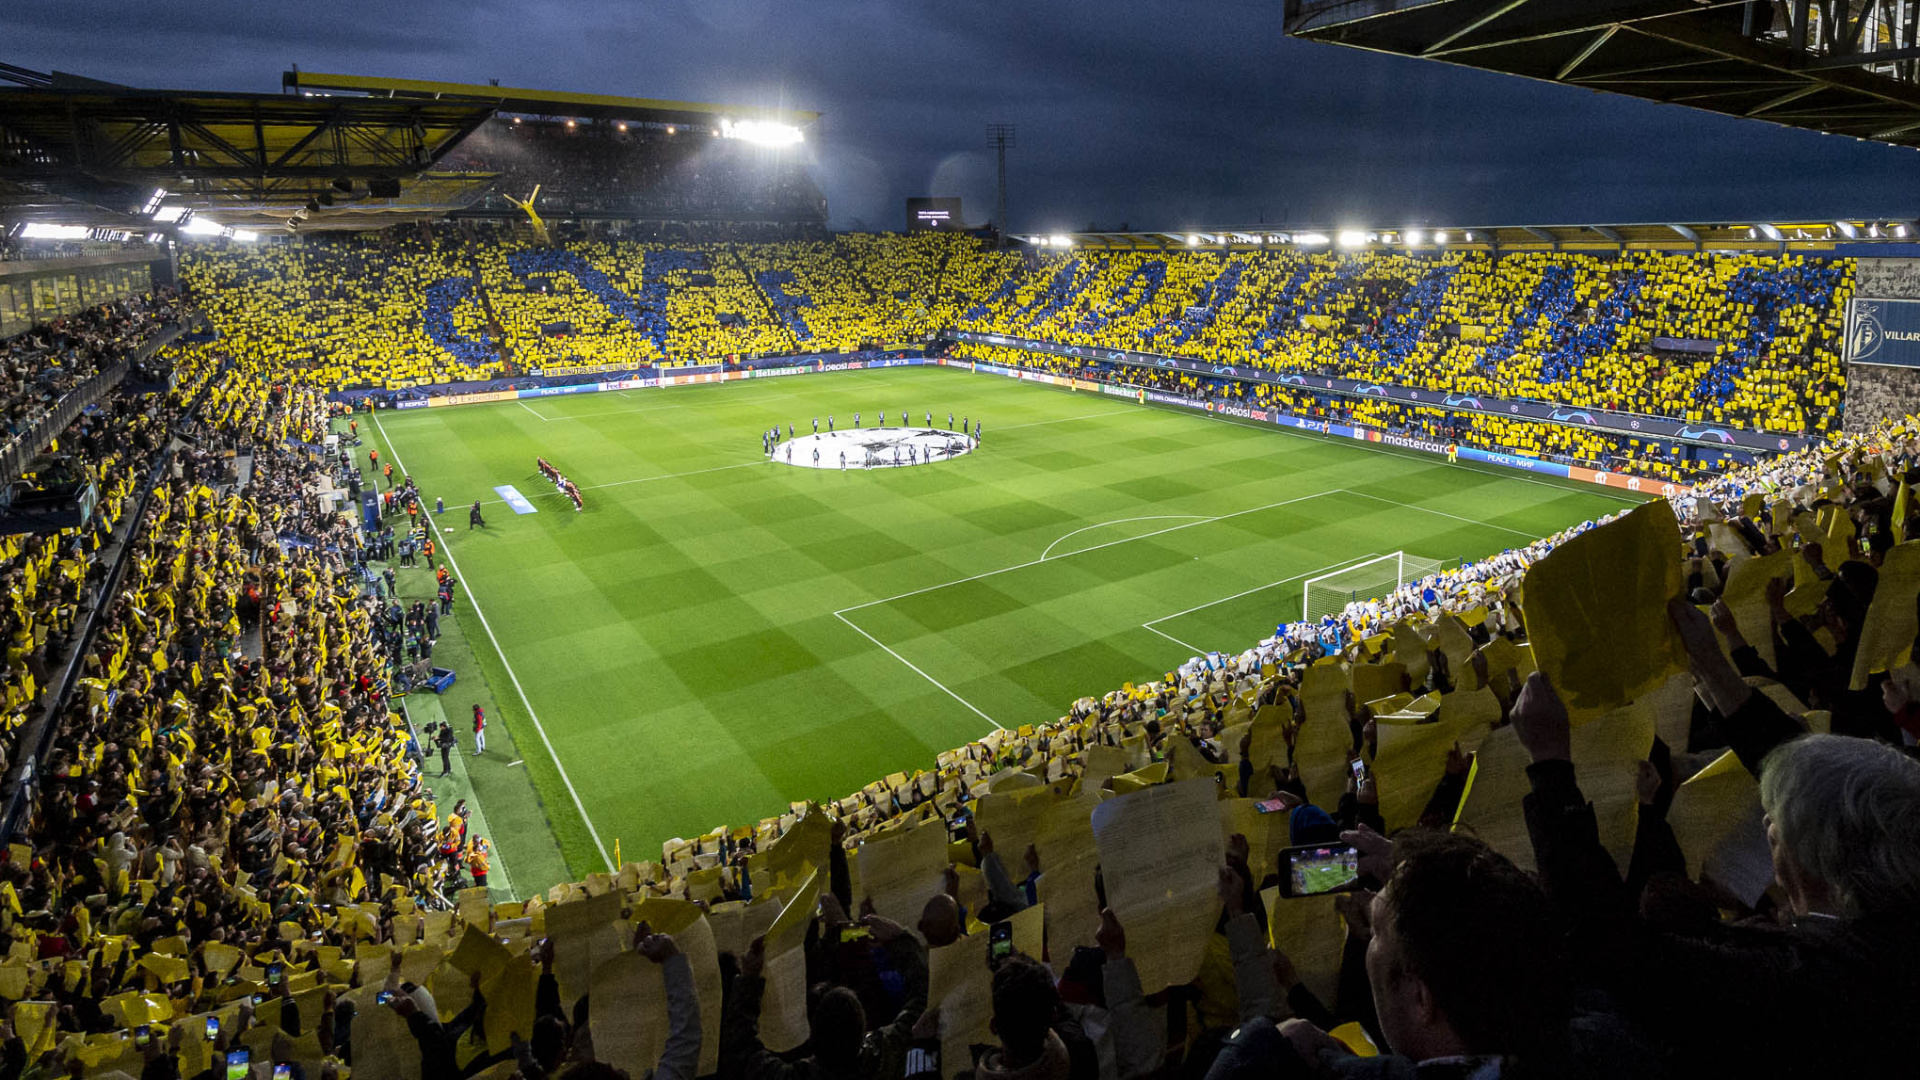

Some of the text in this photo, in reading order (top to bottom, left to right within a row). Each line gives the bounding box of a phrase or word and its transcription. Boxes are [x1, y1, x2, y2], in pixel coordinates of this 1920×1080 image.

[1885, 331, 1920, 341] VILLAR
[825, 362, 847, 371] pepsi
[756, 367, 799, 377] Heineken
[606, 380, 629, 390] FedEx
[1104, 385, 1136, 398] Heineken
[461, 394, 499, 403] Expedia
[1165, 396, 1187, 405] CHAMPIONS
[1226, 406, 1268, 421] pepsi MAX
[1488, 454, 1510, 464] PEACE
